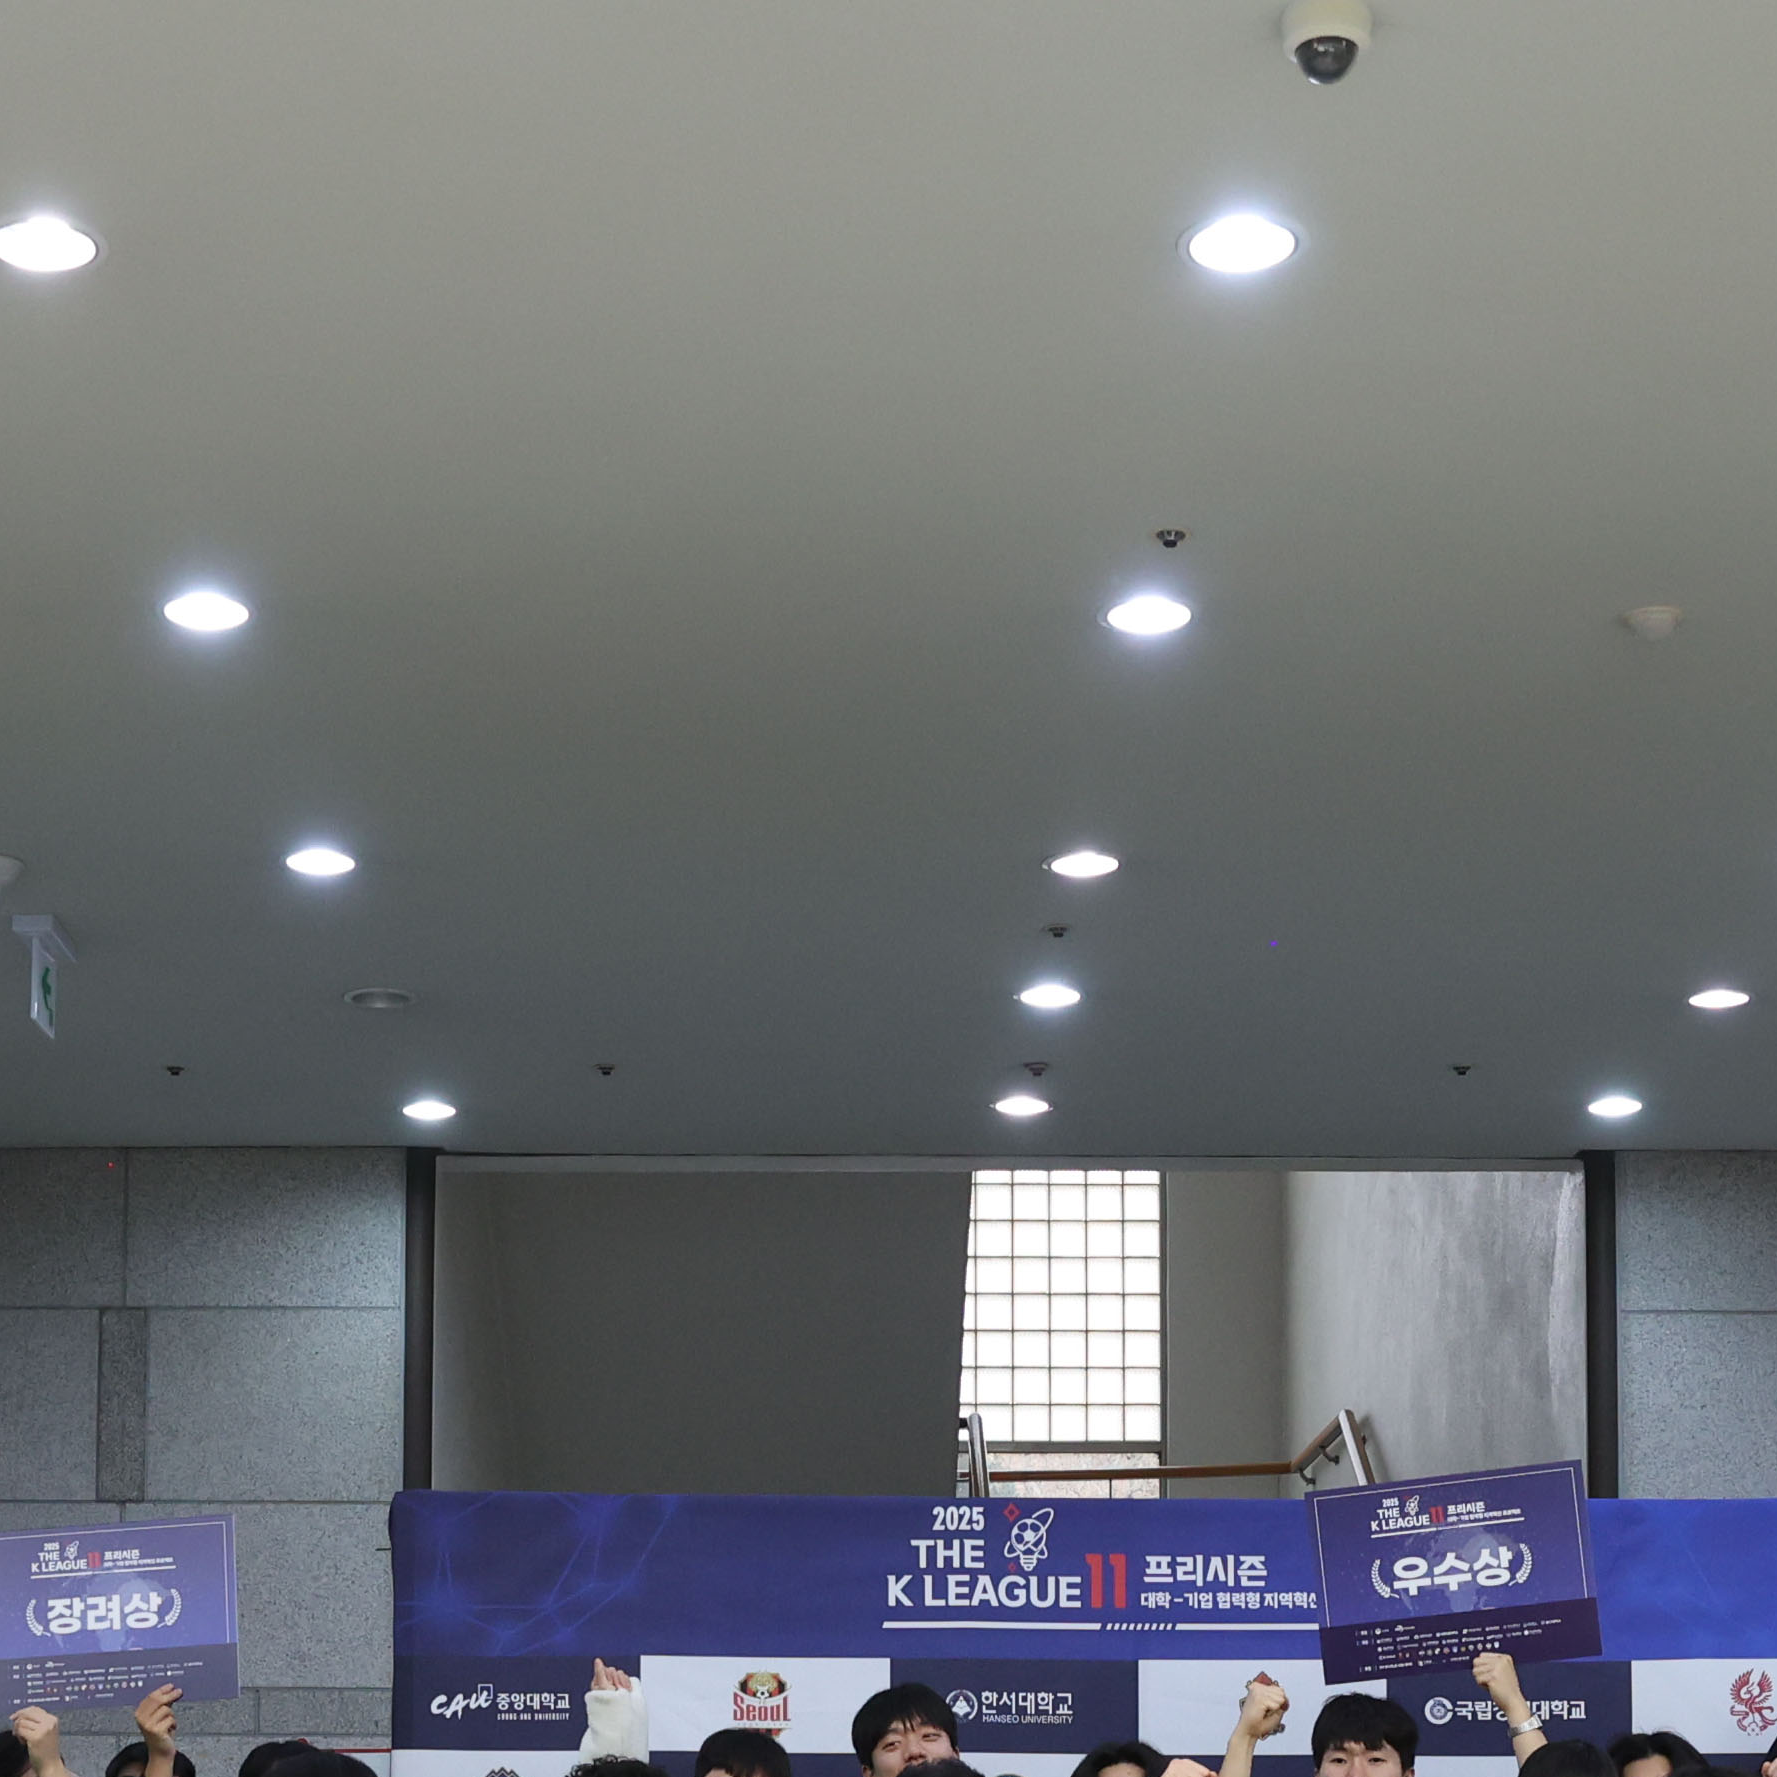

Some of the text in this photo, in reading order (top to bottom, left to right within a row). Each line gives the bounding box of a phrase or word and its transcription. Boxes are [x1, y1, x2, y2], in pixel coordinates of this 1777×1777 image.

[932, 1506, 985, 1531] 2025
[910, 1539, 985, 1569] THE
[887, 1553, 1127, 1609] K LEAGUE 11
[1142, 1554, 1268, 1587] 프리시즌
[1393, 1546, 1513, 1596] 우수상
[47, 1592, 163, 1635] 장려상
[1217, 1592, 1260, 1610] 협력형
[431, 1688, 493, 1720] CAU
[496, 1692, 570, 1710] 중앙대학교
[733, 1692, 791, 1721] Seoul
[981, 1691, 1073, 1716] 한서대학교
[1455, 1700, 1586, 1720] 국립대학교
[983, 1714, 1073, 1725] HANSEO UNIVERSITY
